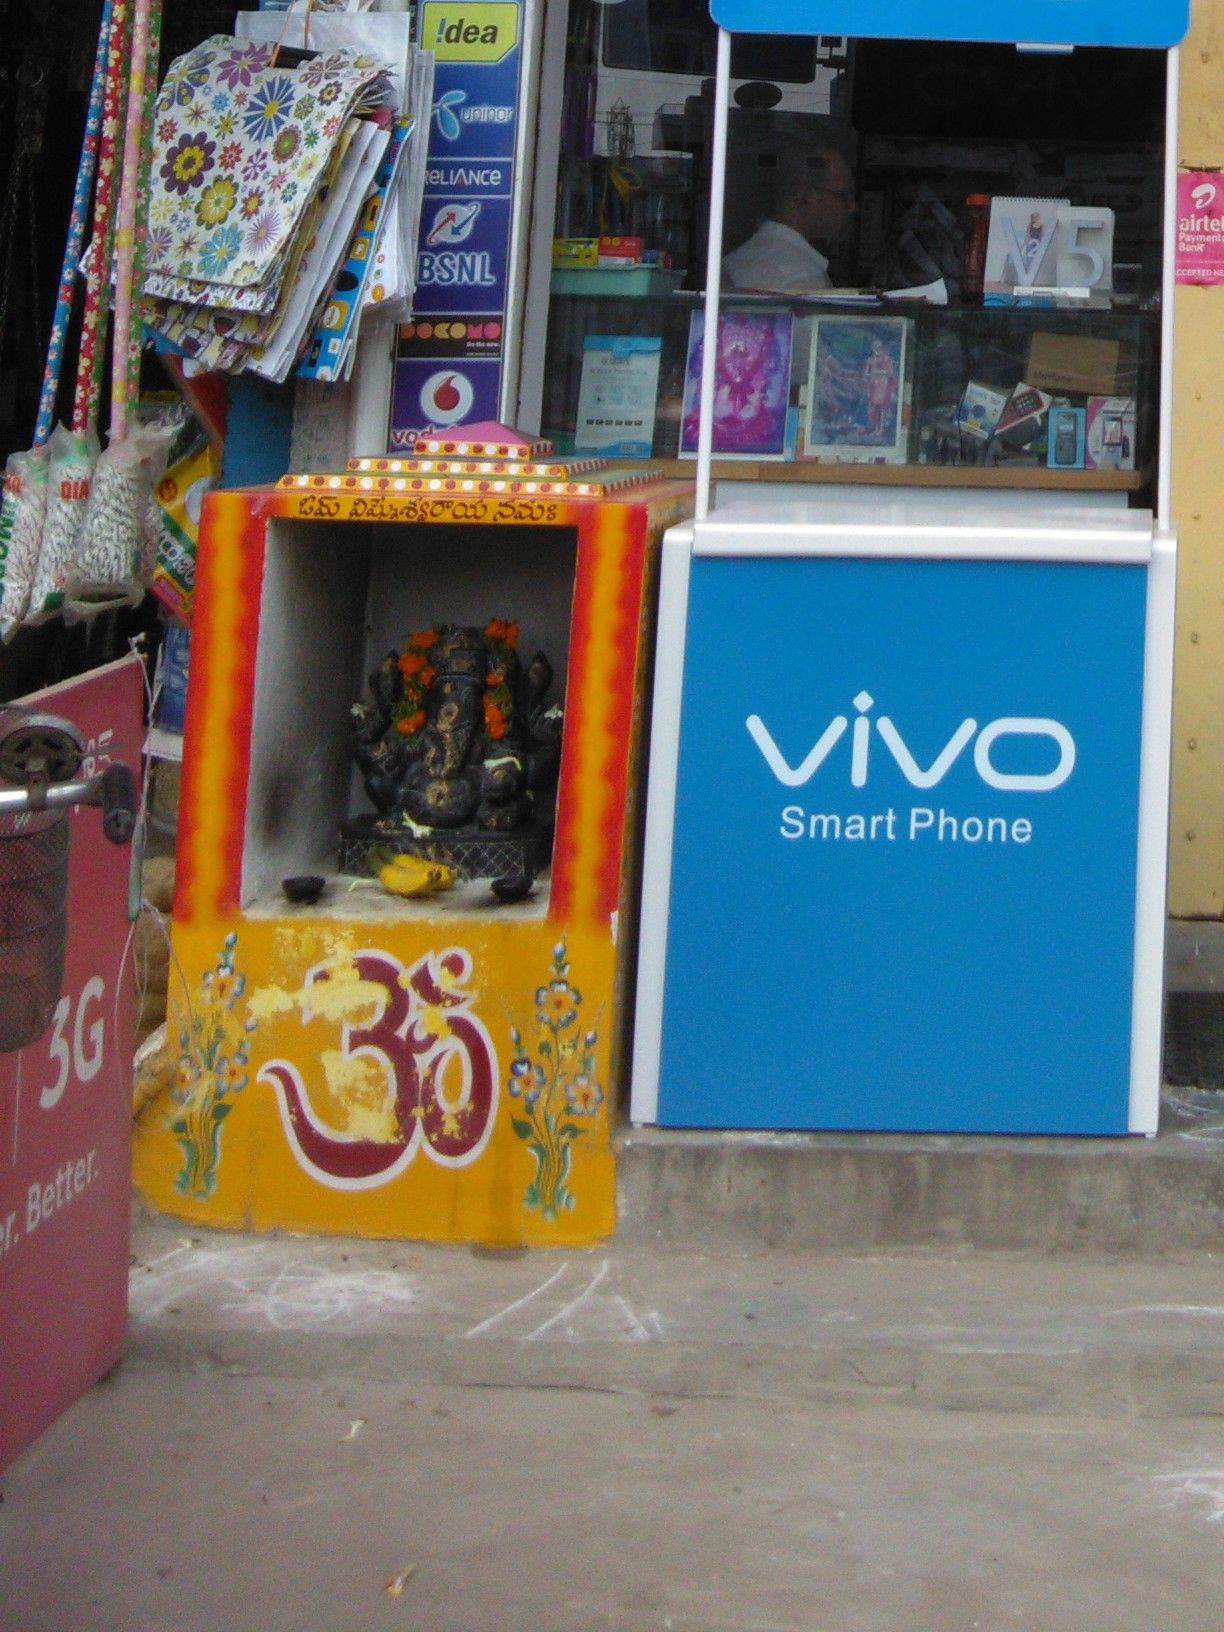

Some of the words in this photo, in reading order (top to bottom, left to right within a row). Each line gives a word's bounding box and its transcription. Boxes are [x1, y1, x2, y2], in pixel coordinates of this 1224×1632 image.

[416, 251, 497, 285] BSNL
[1178, 243, 1205, 252] Bank
[746, 690, 1076, 791] vivo
[779, 805, 896, 840] Smart
[909, 807, 1033, 843] Phone
[40, 975, 105, 1109] 3G
[26, 1149, 99, 1233] Better.
